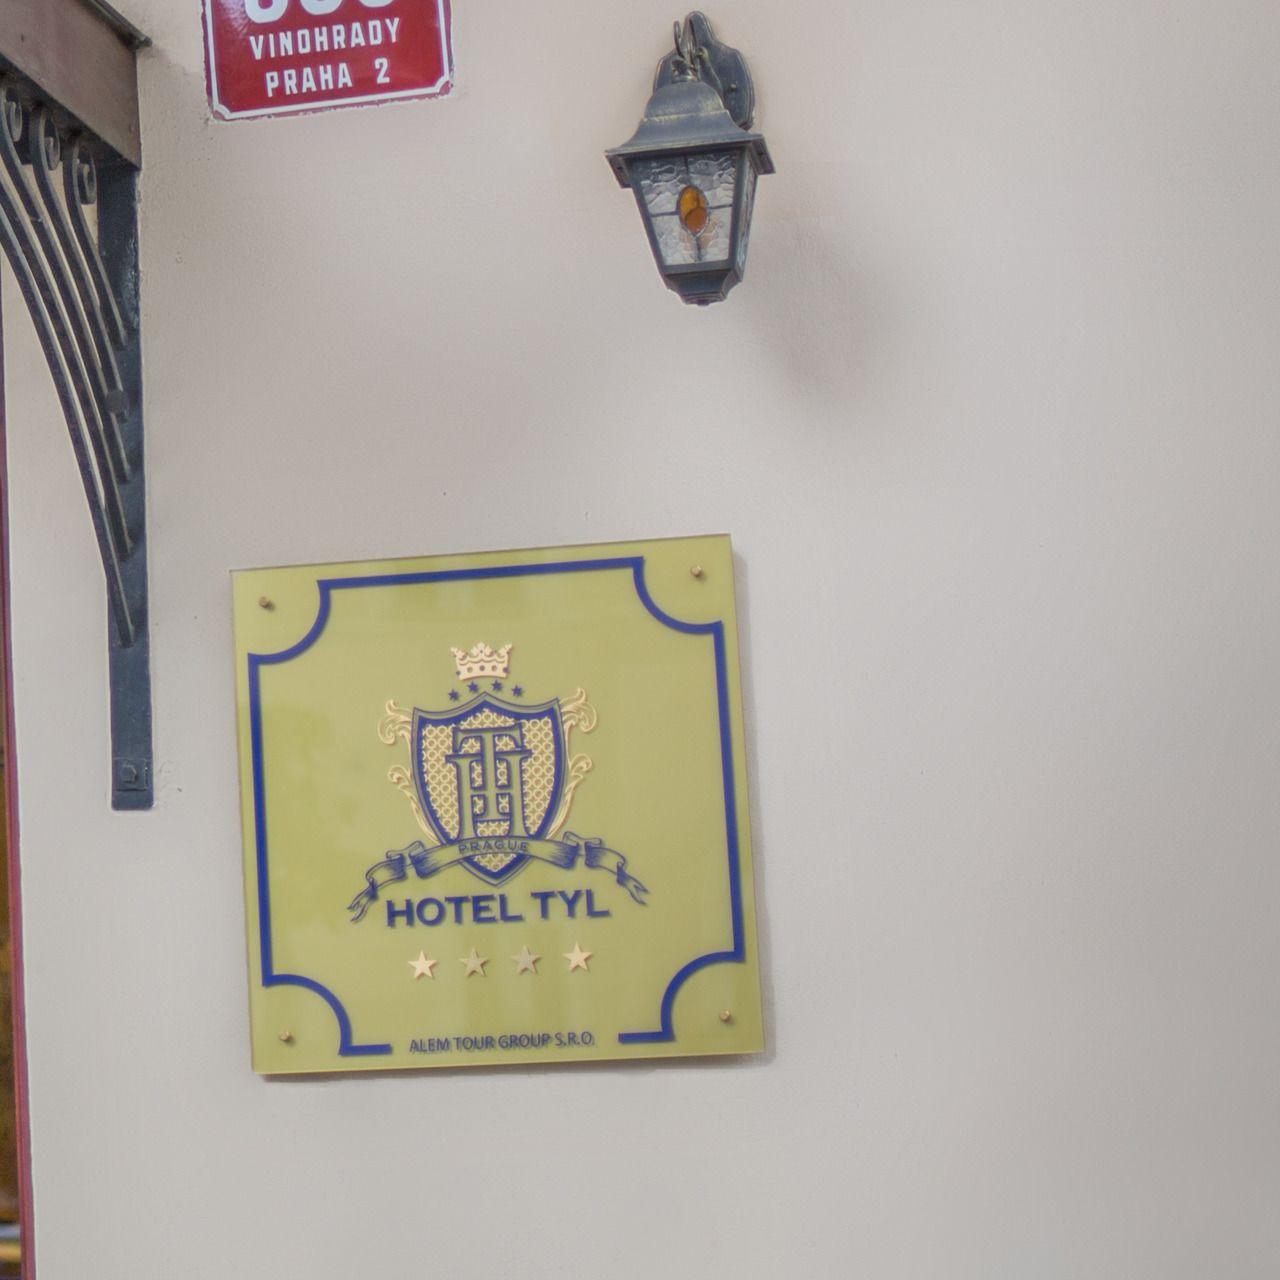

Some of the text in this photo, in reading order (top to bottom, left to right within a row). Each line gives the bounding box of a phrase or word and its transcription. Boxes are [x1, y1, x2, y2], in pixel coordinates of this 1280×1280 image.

[249, 17, 400, 61] VINOHRADY
[265, 57, 390, 97] PRAHA 2
[458, 839, 528, 853] PRAGUE
[386, 888, 612, 927] HOTEL TYL
[409, 1037, 450, 1053] ALEM
[453, 1035, 495, 1051] TOUR
[498, 1032, 551, 1049] GROUP
